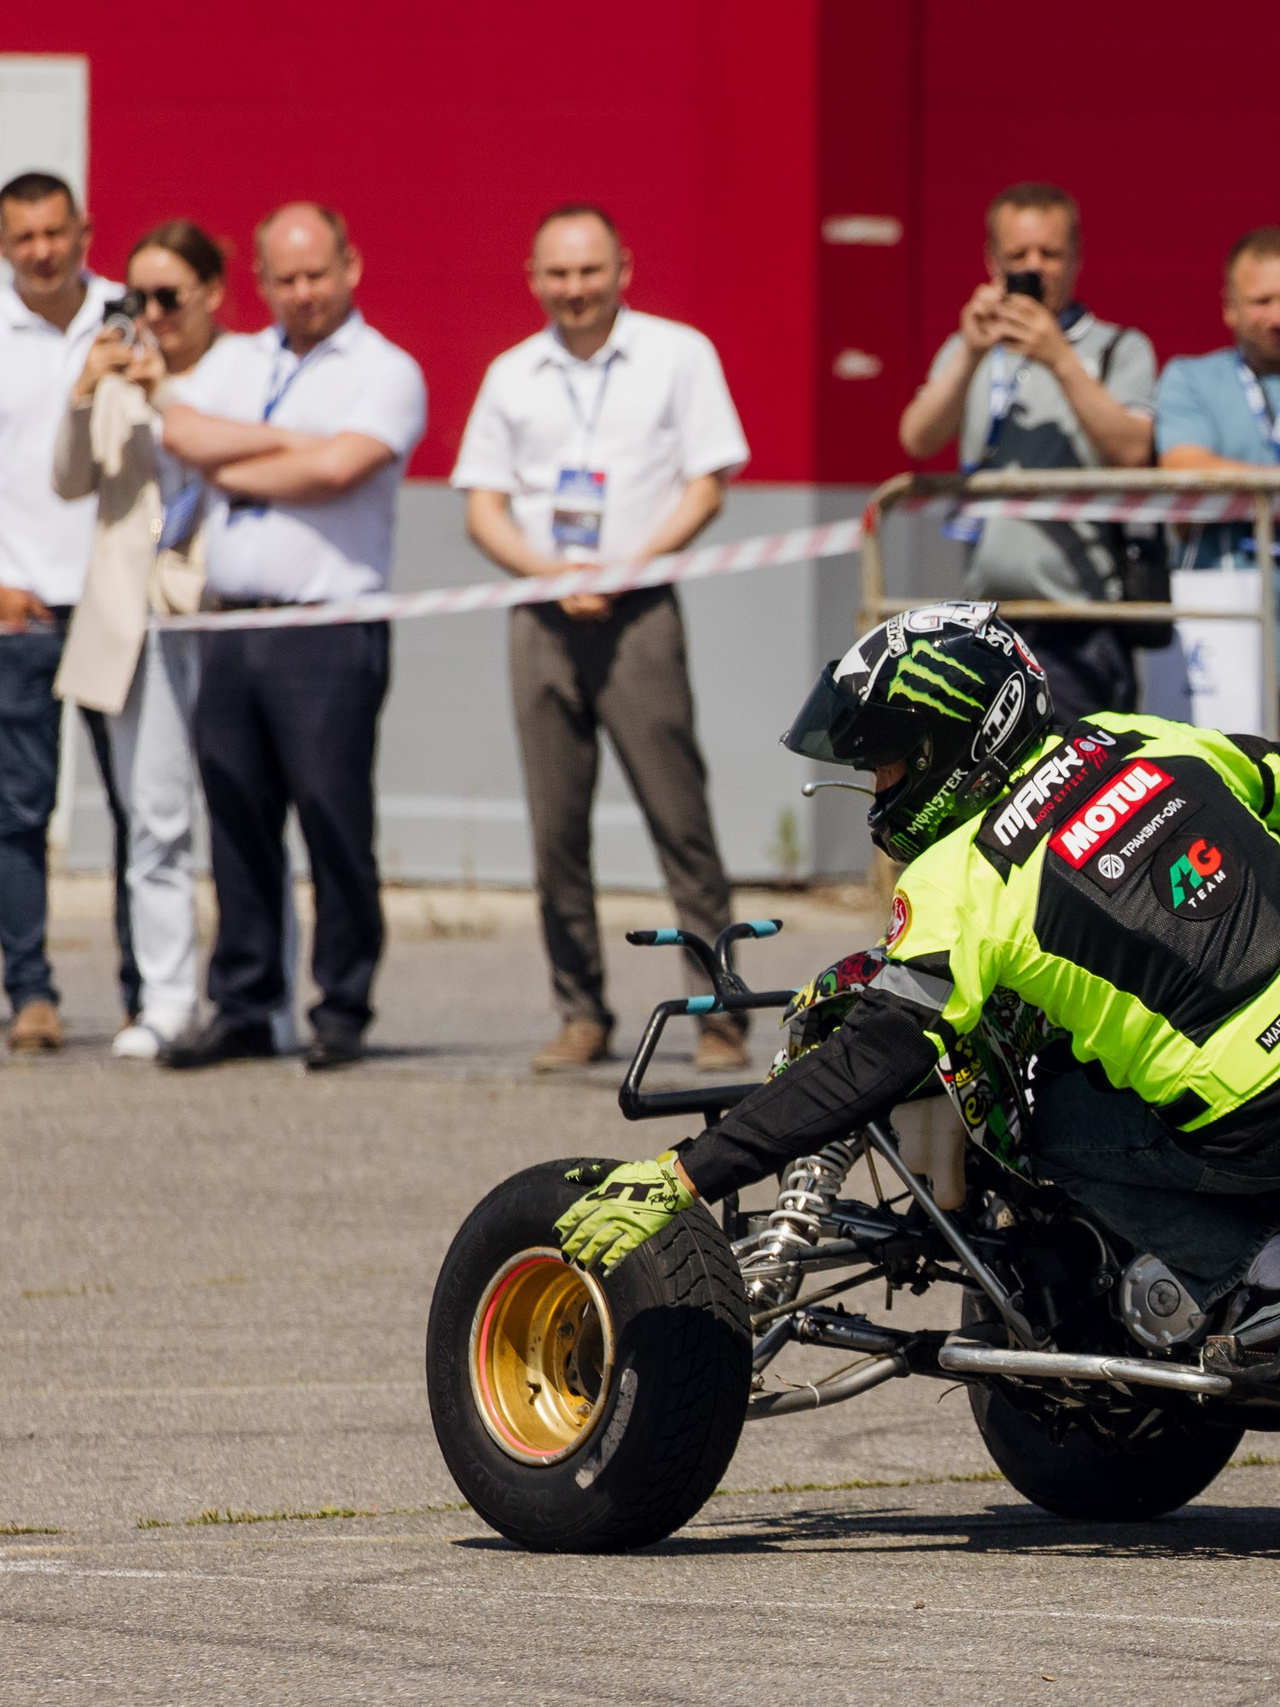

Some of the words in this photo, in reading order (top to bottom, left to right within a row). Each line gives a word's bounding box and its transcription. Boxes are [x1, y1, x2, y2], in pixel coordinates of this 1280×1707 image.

[1034, 801, 1055, 825] MOTO
[1053, 767, 1089, 803] EXPERT
[1060, 766, 1163, 860] MOTUL
[1119, 797, 1187, 858] ТРАНЗИТ-ОЙЛ
[1169, 838, 1222, 909] AG
[1187, 869, 1227, 909] TEAM
